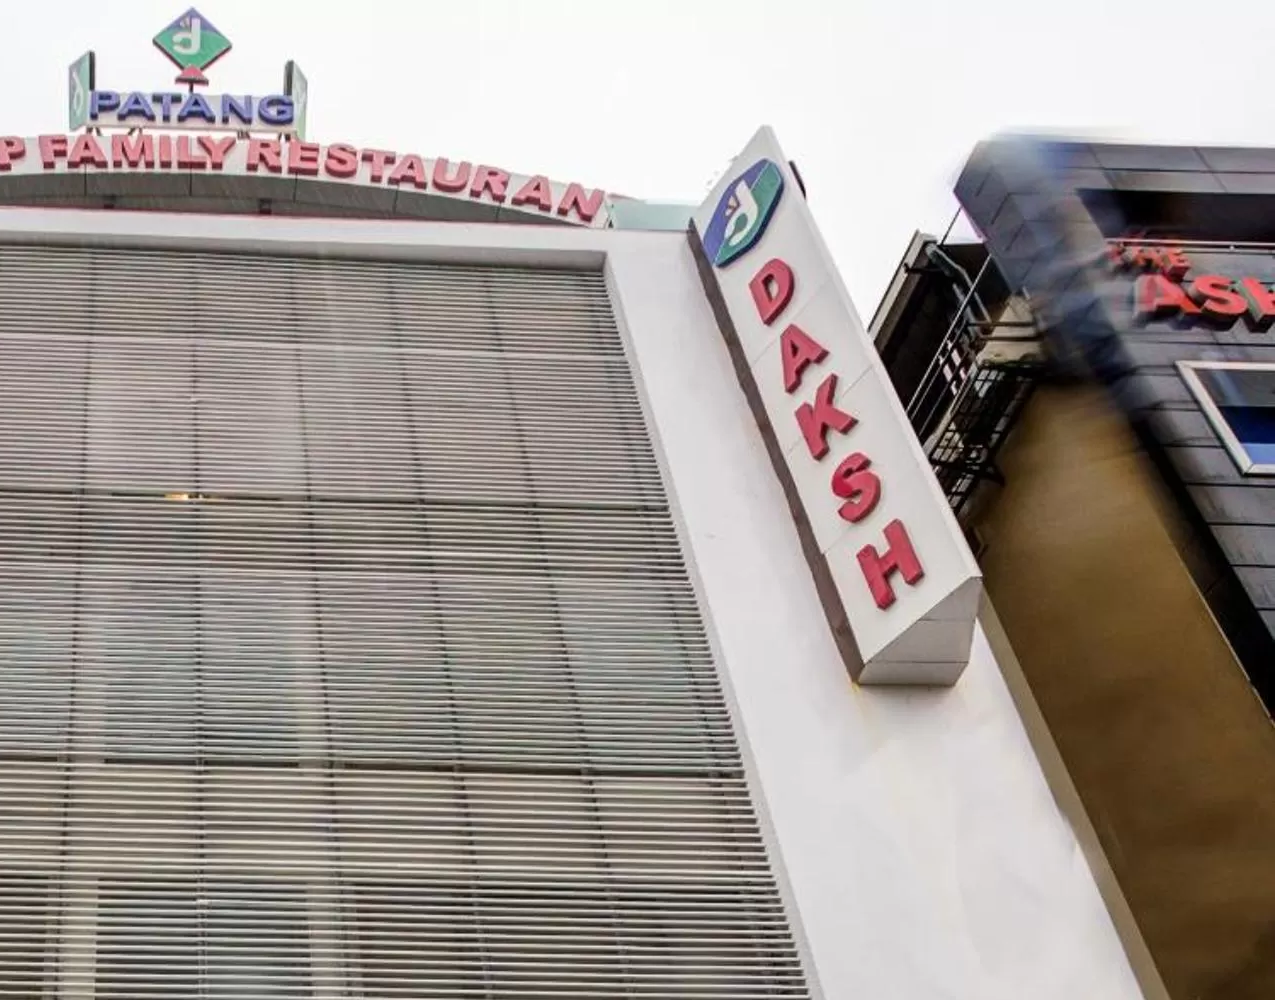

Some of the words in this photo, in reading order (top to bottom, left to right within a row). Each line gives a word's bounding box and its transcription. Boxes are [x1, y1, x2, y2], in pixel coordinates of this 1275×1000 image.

[89, 90, 294, 125] PATANG
[38, 134, 237, 169] FAMILY
[246, 138, 608, 222] RESTAURAN
[748, 258, 925, 611] DAKSH
